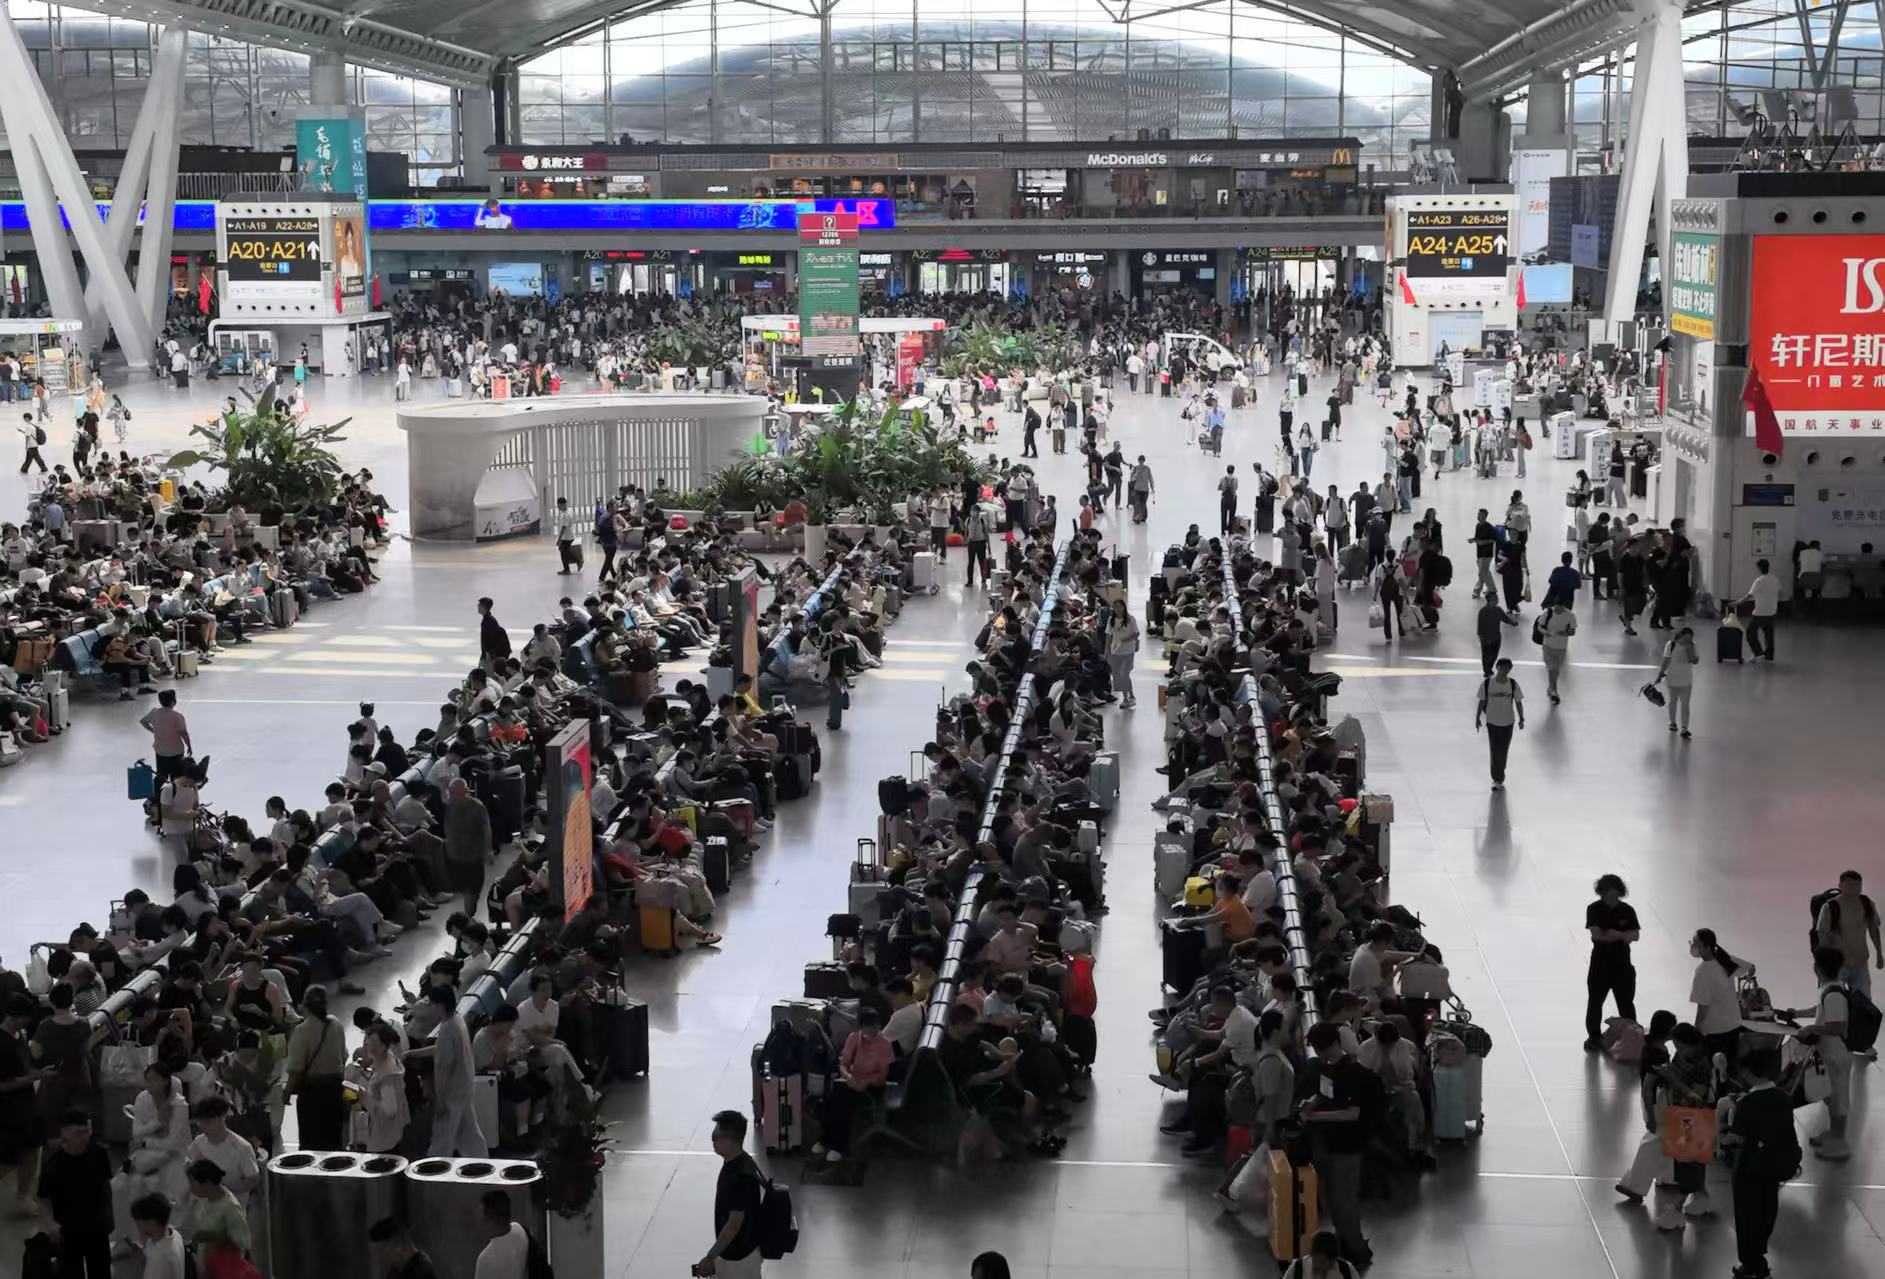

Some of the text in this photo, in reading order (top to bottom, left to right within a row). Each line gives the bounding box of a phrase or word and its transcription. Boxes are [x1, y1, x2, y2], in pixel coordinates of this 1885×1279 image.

[1087, 153, 1167, 165] McDonald's
[1259, 152, 1299, 163] 麦当劳
[541, 157, 584, 169] 永和大王
[1417, 215, 1452, 224] A1-A23
[235, 222, 267, 230] A1-A19
[584, 250, 603, 260] A20
[1247, 247, 1268, 257] A24
[1165, 254, 1208, 263] 星巴克咖啡
[1770, 333, 1885, 367] 轩尼斯
